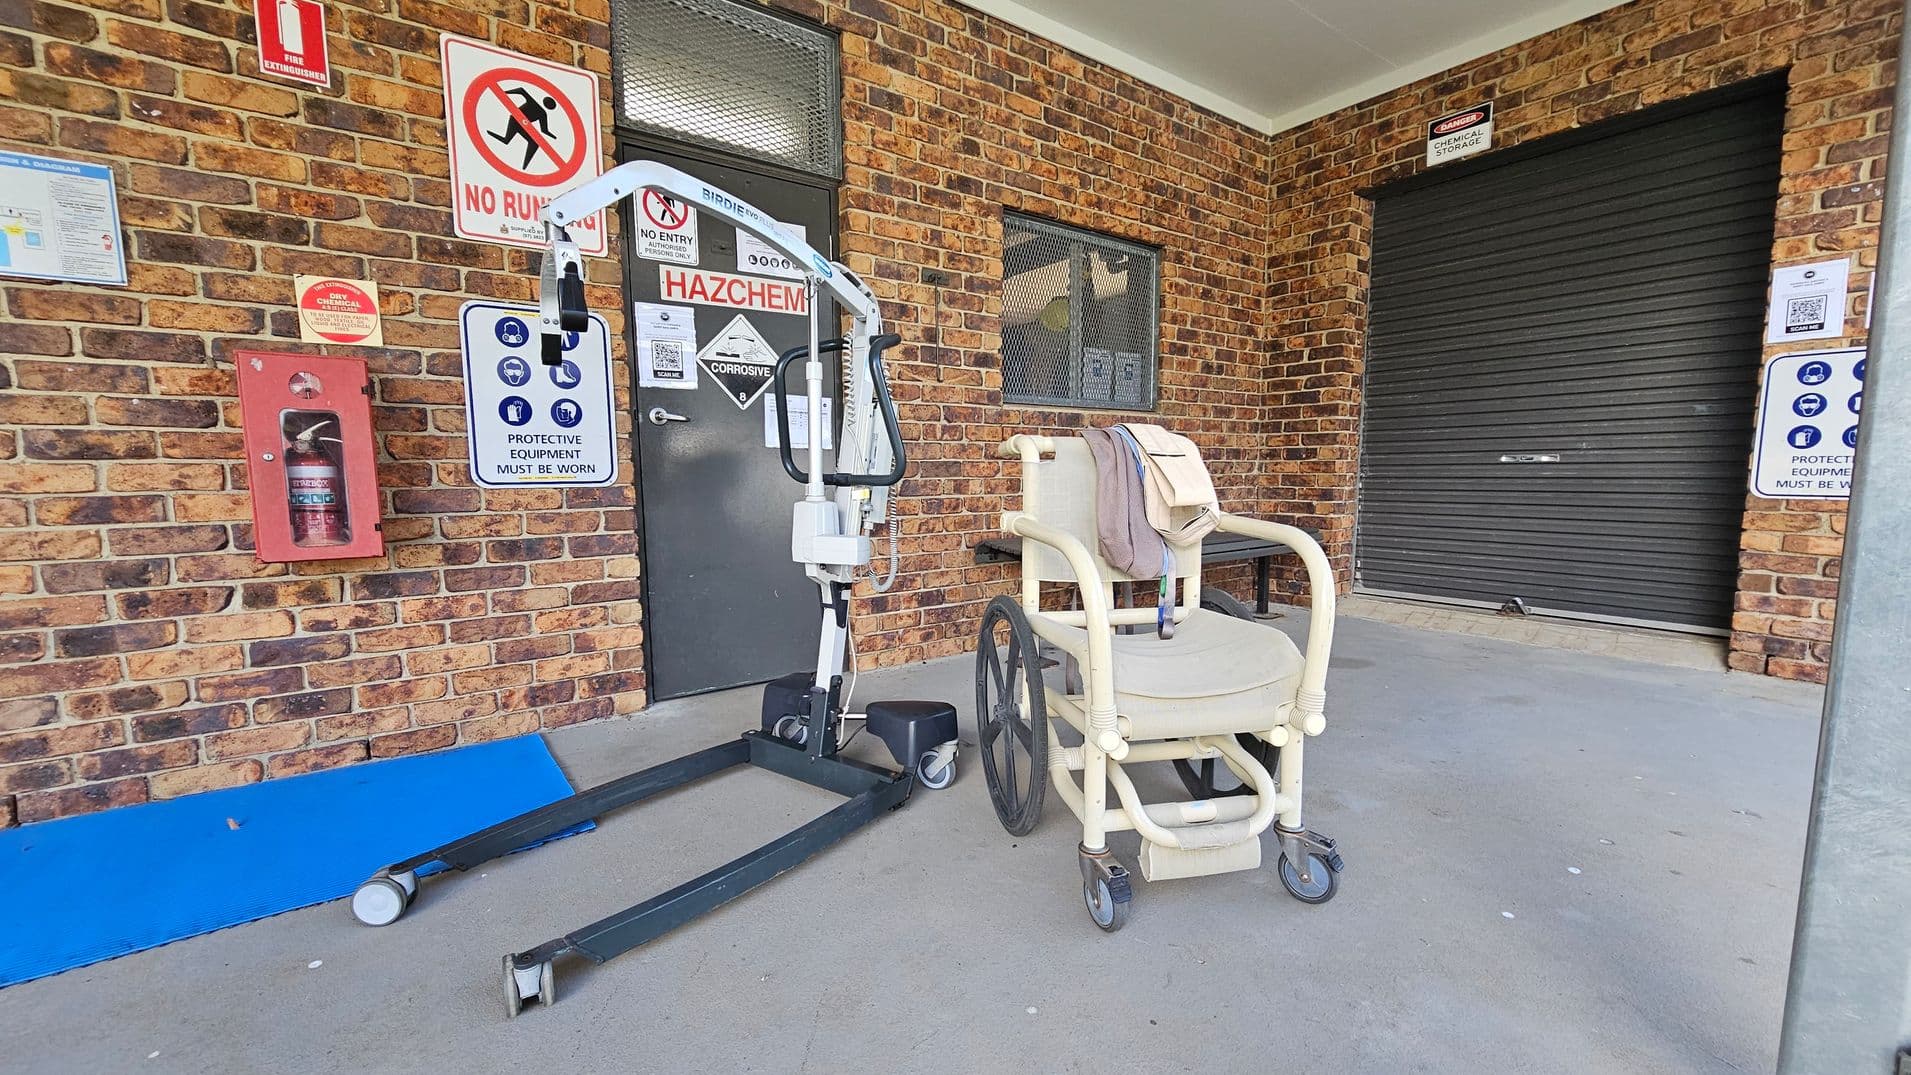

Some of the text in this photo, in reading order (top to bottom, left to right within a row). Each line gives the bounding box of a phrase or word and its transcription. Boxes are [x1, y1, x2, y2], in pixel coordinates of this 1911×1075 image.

[284, 54, 305, 65] FIRE
[264, 60, 327, 82] EXTINGUISHER
[1440, 114, 1477, 131] DANGER
[1434, 129, 1484, 150] CHEMICAL
[1436, 137, 1482, 156] STORAGE
[464, 183, 596, 231] NO RUNG
[702, 187, 745, 218] BIRDIE
[745, 208, 759, 220] EVO
[640, 228, 693, 246] NO ENTRY
[648, 241, 688, 253] AUTHORISED
[644, 247, 691, 260] PERSONS ONLY
[329, 292, 348, 301] DRY
[665, 270, 806, 313] HAZCHEM
[316, 298, 361, 308] CHEMICAL
[710, 361, 772, 377] CORROSIVE
[739, 392, 747, 401] 8
[507, 433, 583, 445] PROTECTIVE
[510, 449, 582, 460] EQUIPMENT
[497, 464, 596, 475] MUST BE WORN
[1791, 467, 1851, 477] EQUIPME
[1775, 480, 1813, 489] MUST
[1818, 480, 1834, 489] BE
